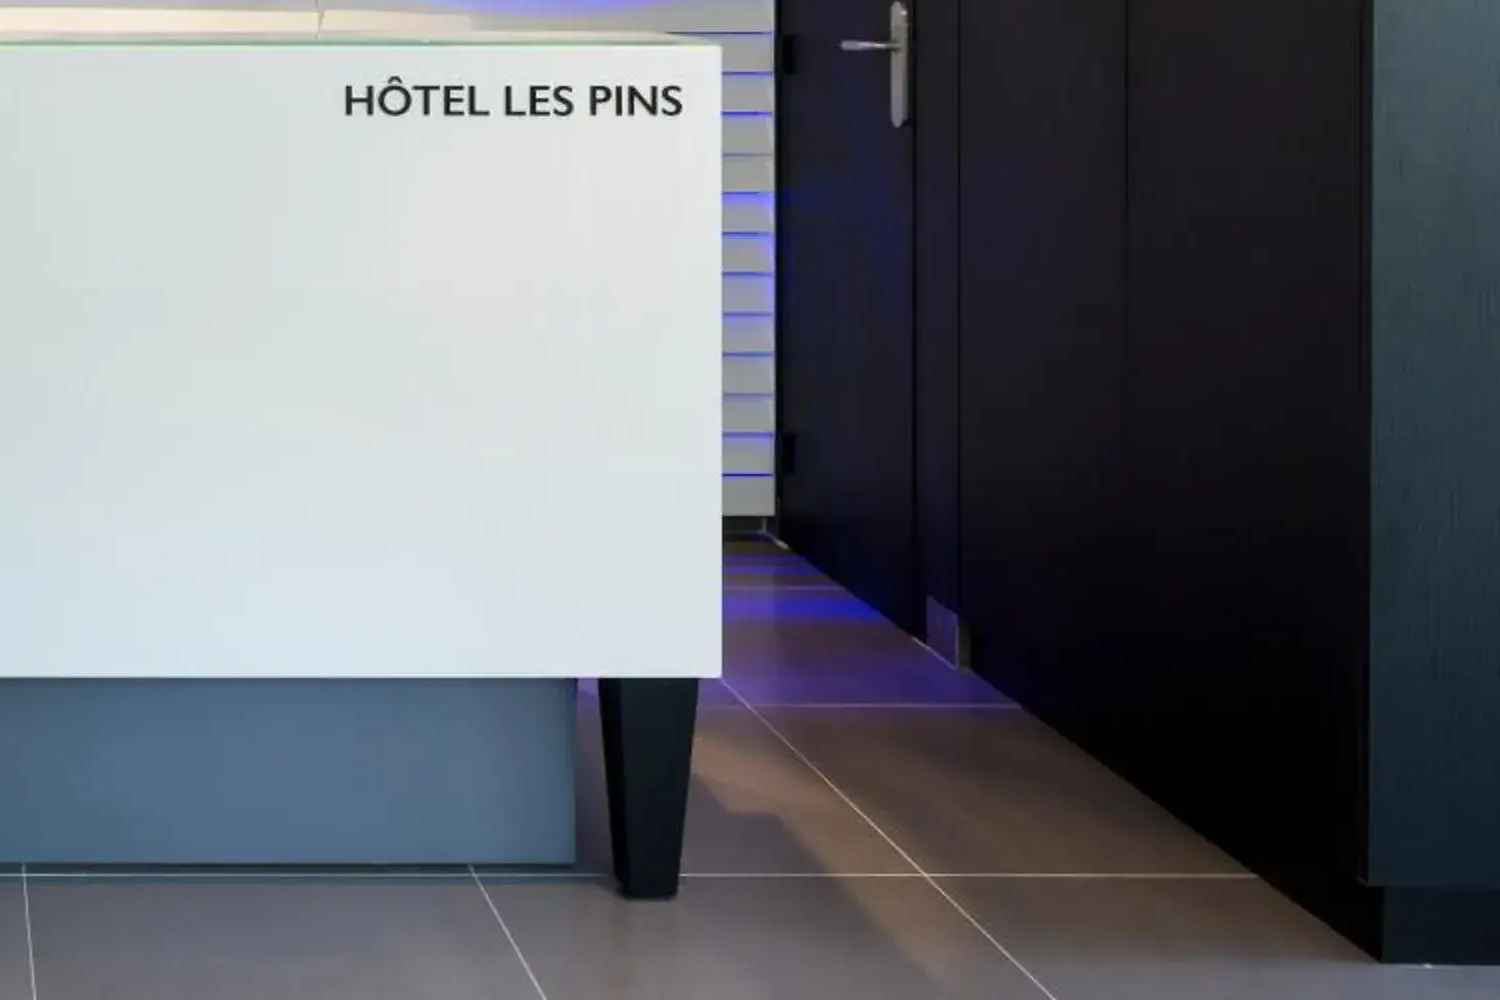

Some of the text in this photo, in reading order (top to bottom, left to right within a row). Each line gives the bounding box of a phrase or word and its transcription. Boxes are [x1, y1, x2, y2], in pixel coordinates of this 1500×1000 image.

[345, 75, 683, 116] HÔTEL LES PINS
